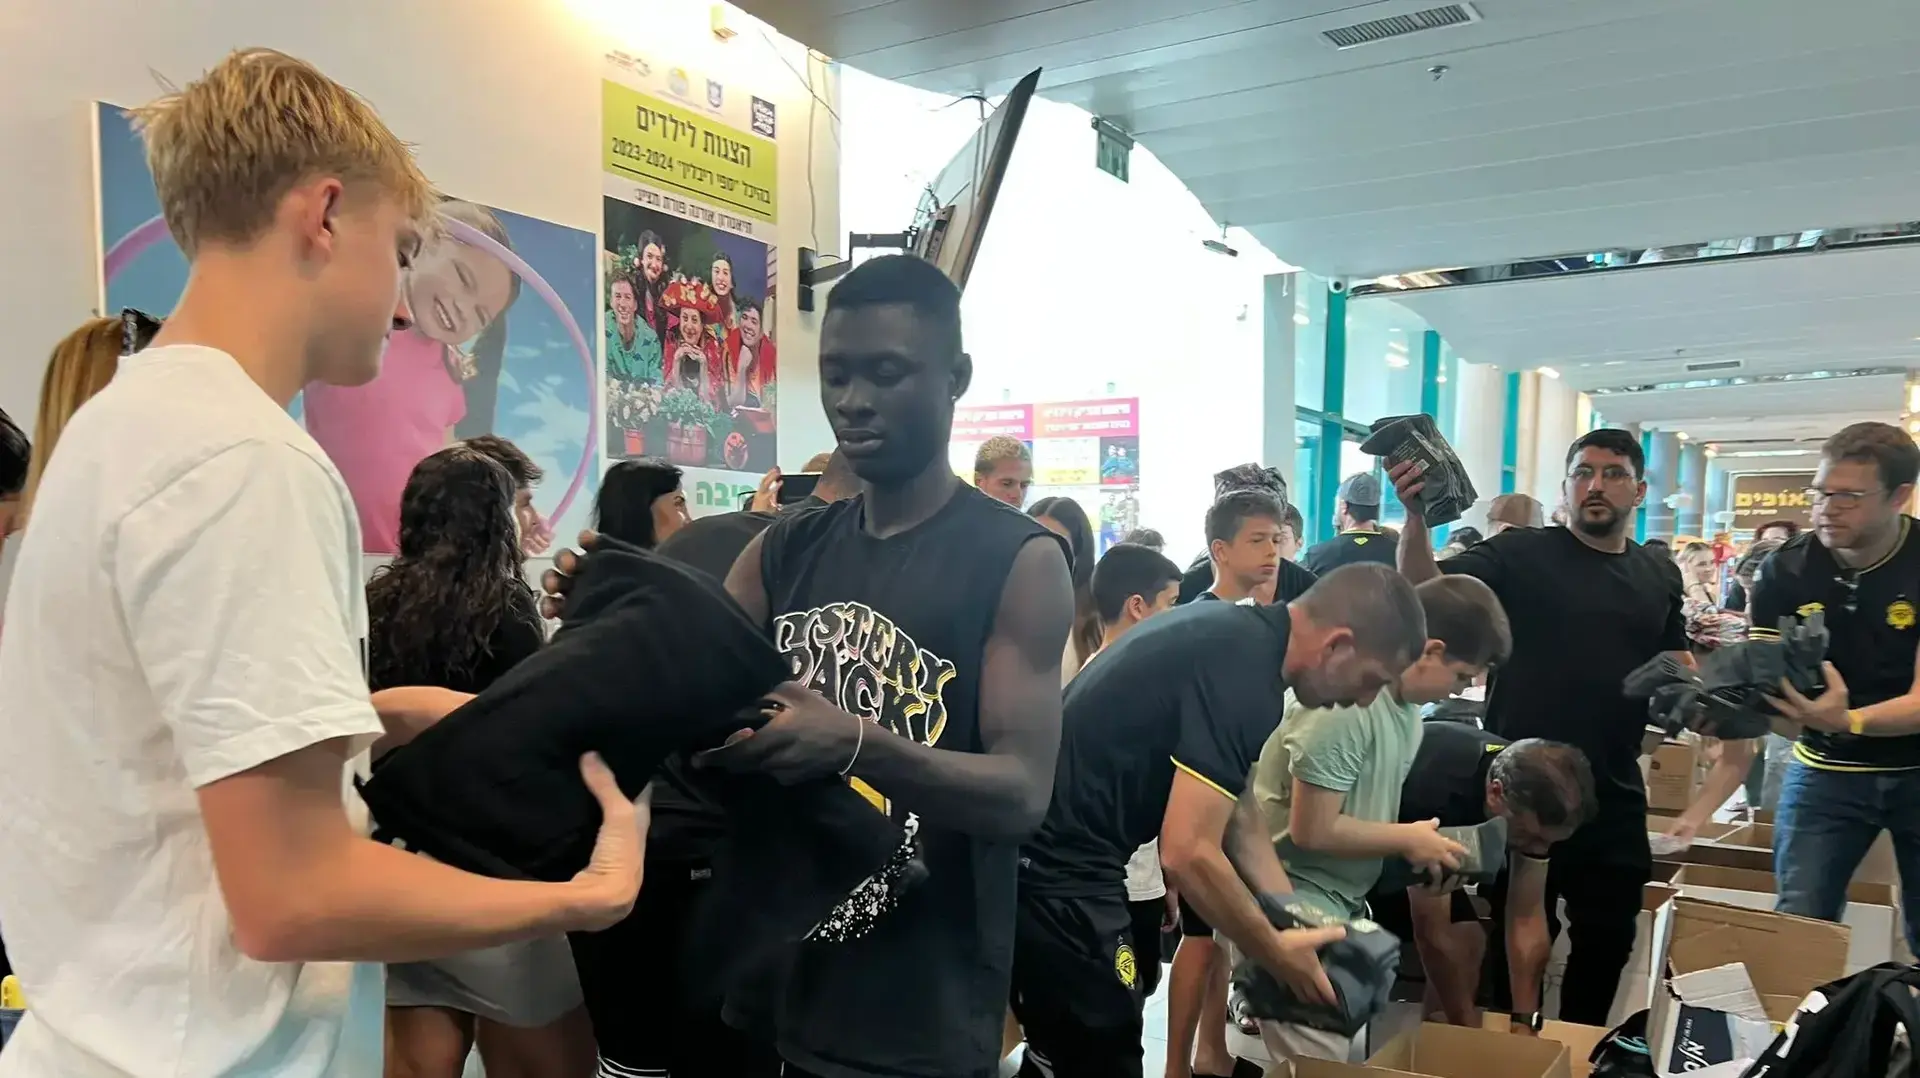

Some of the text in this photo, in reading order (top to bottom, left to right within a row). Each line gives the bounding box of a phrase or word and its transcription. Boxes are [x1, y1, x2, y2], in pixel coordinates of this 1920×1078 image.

[611, 136, 673, 172] 2023-2024
[636, 104, 751, 168] הצגות לילדים
[774, 601, 957, 703] YSTERY
